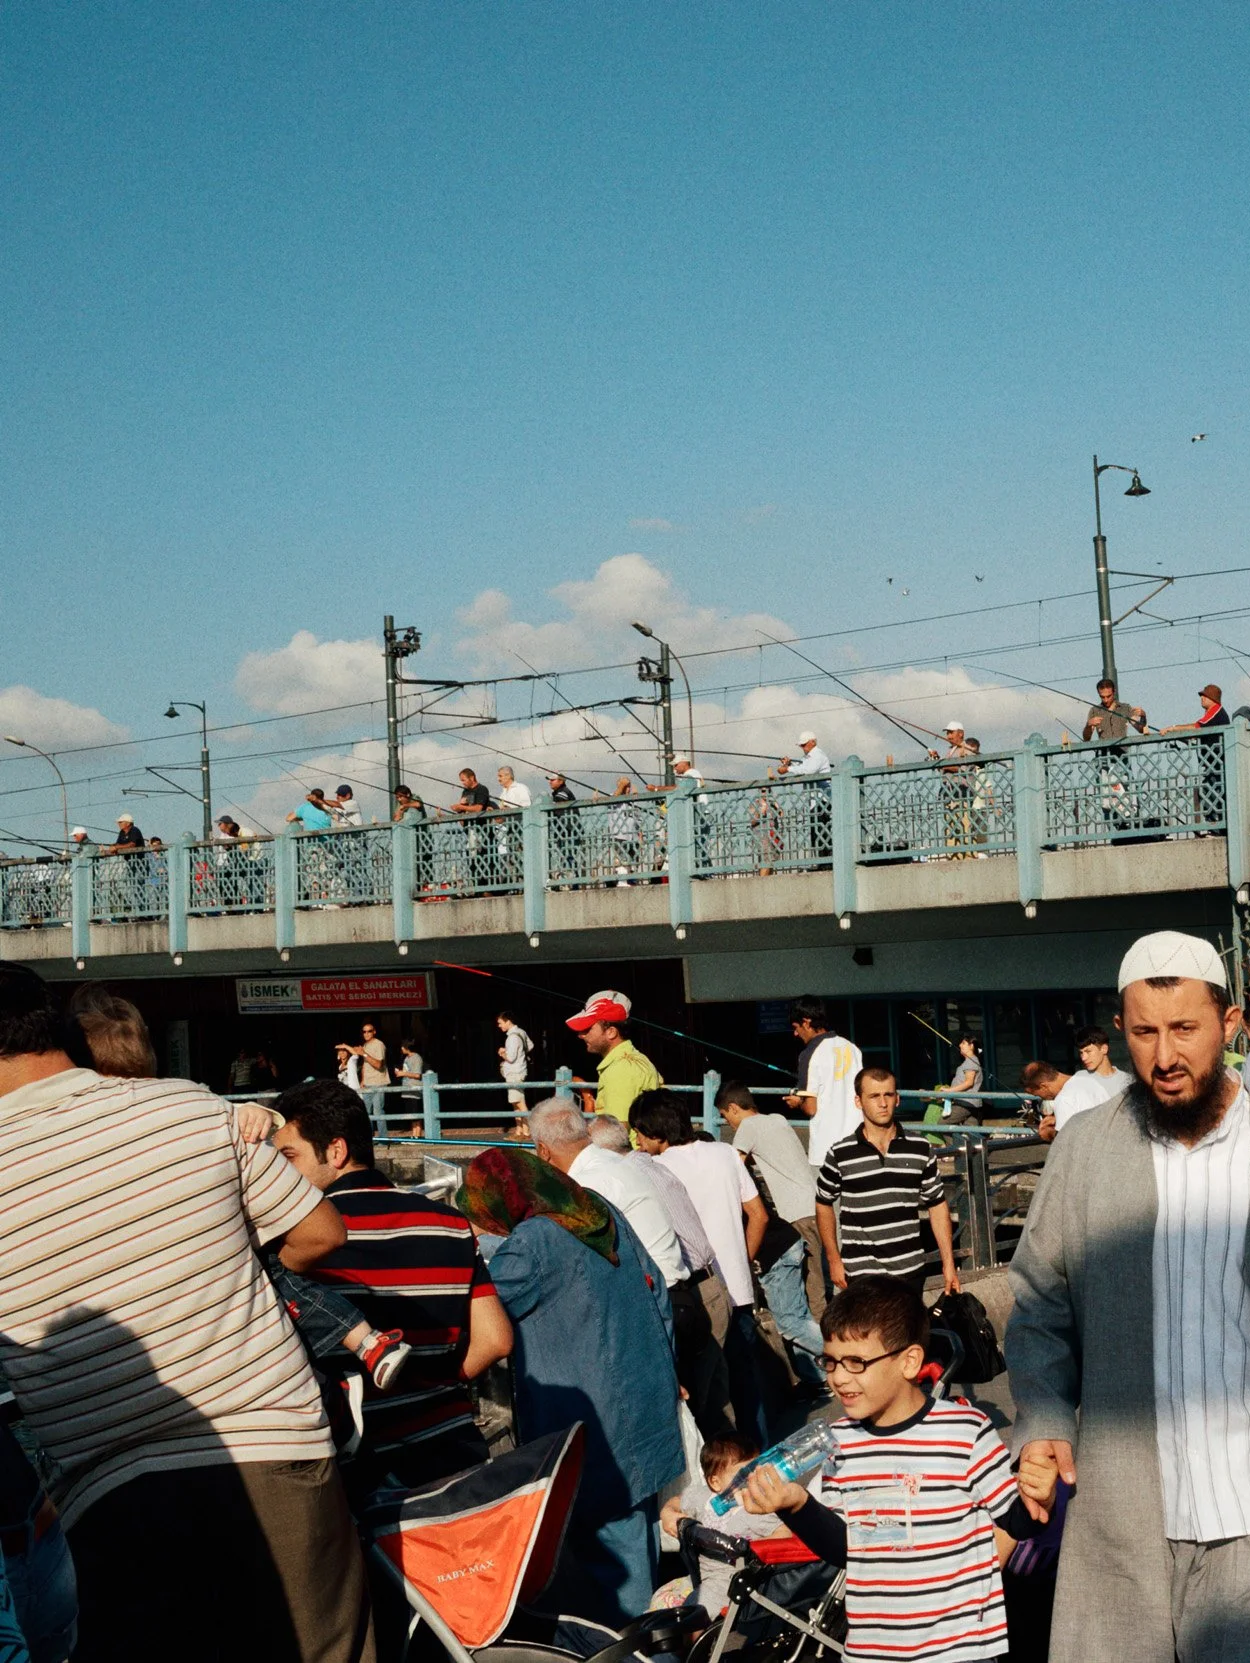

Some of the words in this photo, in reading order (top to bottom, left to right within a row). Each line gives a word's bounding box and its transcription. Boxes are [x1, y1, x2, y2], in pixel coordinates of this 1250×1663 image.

[250, 981, 290, 998] İSMEK
[311, 981, 346, 992] GALATA
[349, 981, 361, 991] EL
[437, 1567, 467, 1584] BABY
[468, 1559, 495, 1576] MAX
